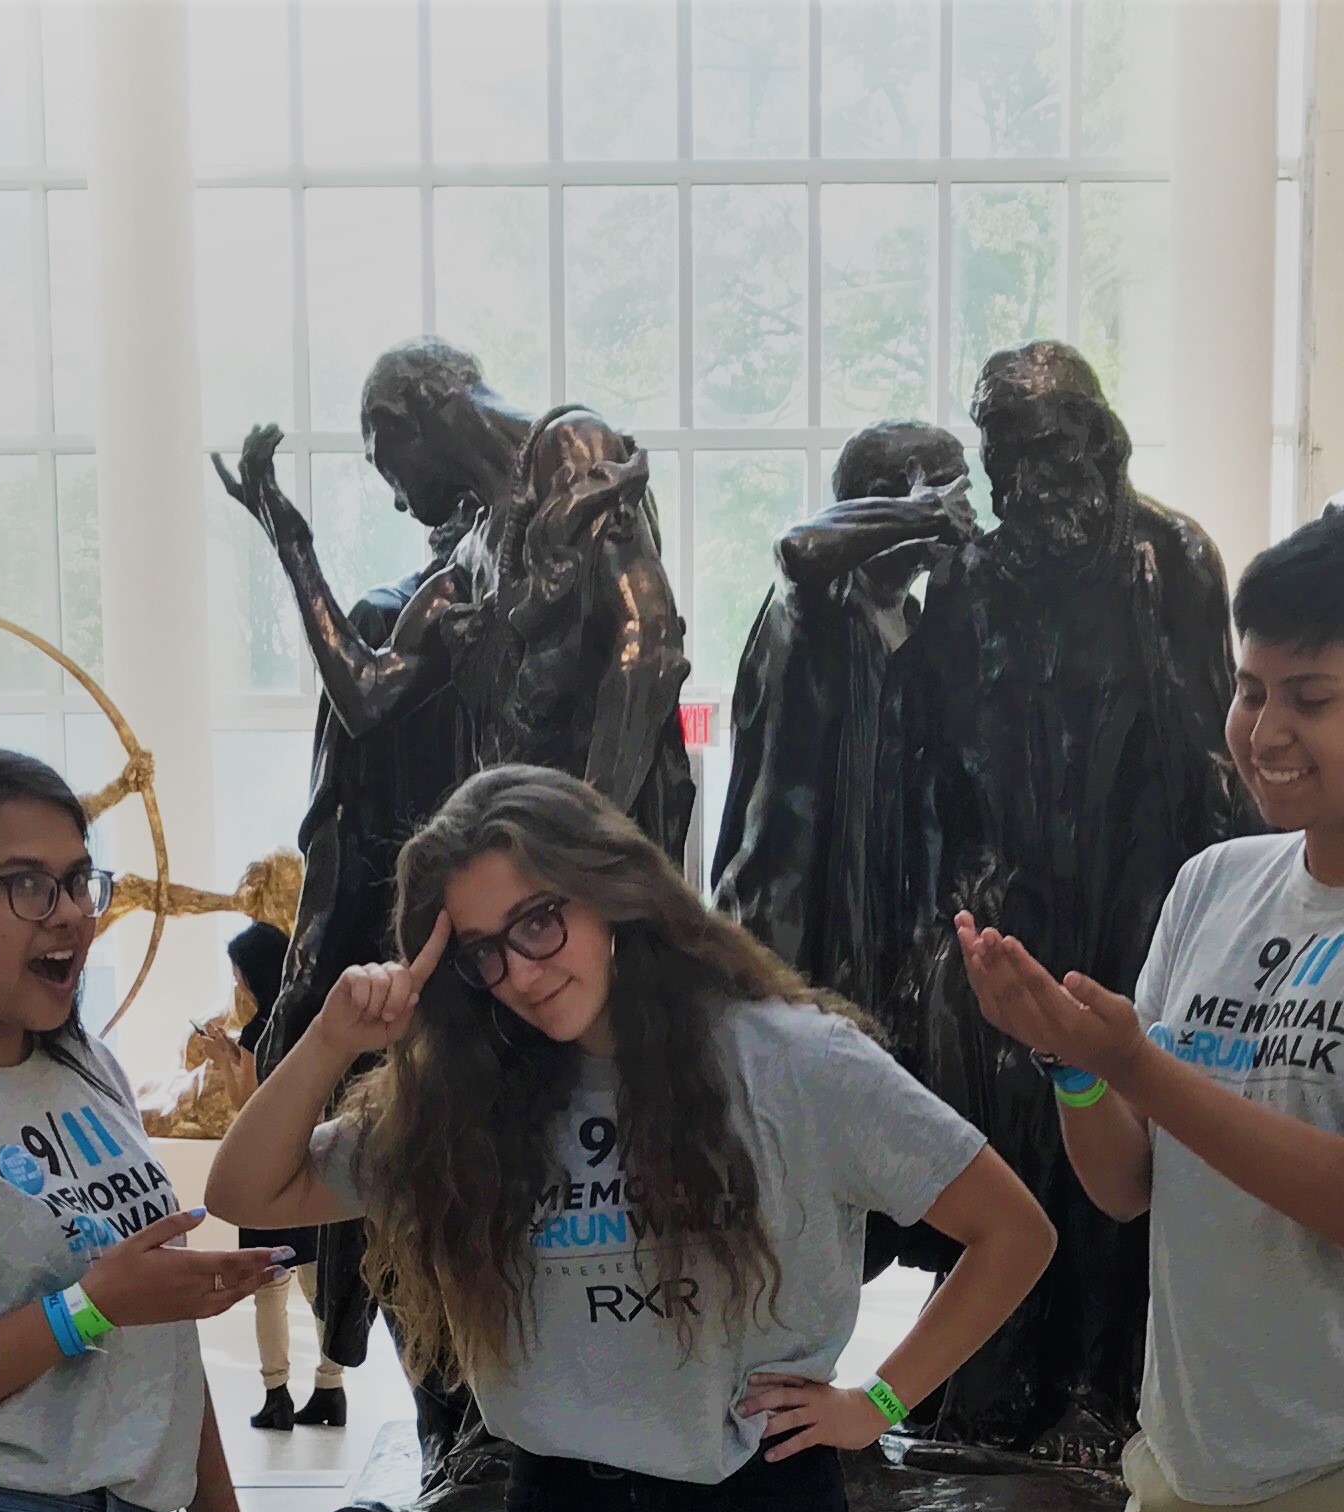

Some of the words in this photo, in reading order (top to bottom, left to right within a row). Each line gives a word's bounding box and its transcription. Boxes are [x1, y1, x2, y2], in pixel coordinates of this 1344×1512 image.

[678, 704, 713, 744] XIT
[20, 1105, 124, 1180] 9/11
[40, 1160, 172, 1218] MEMORIA
[585, 1277, 701, 1323] RXR
[873, 1388, 898, 1415] TAKE
